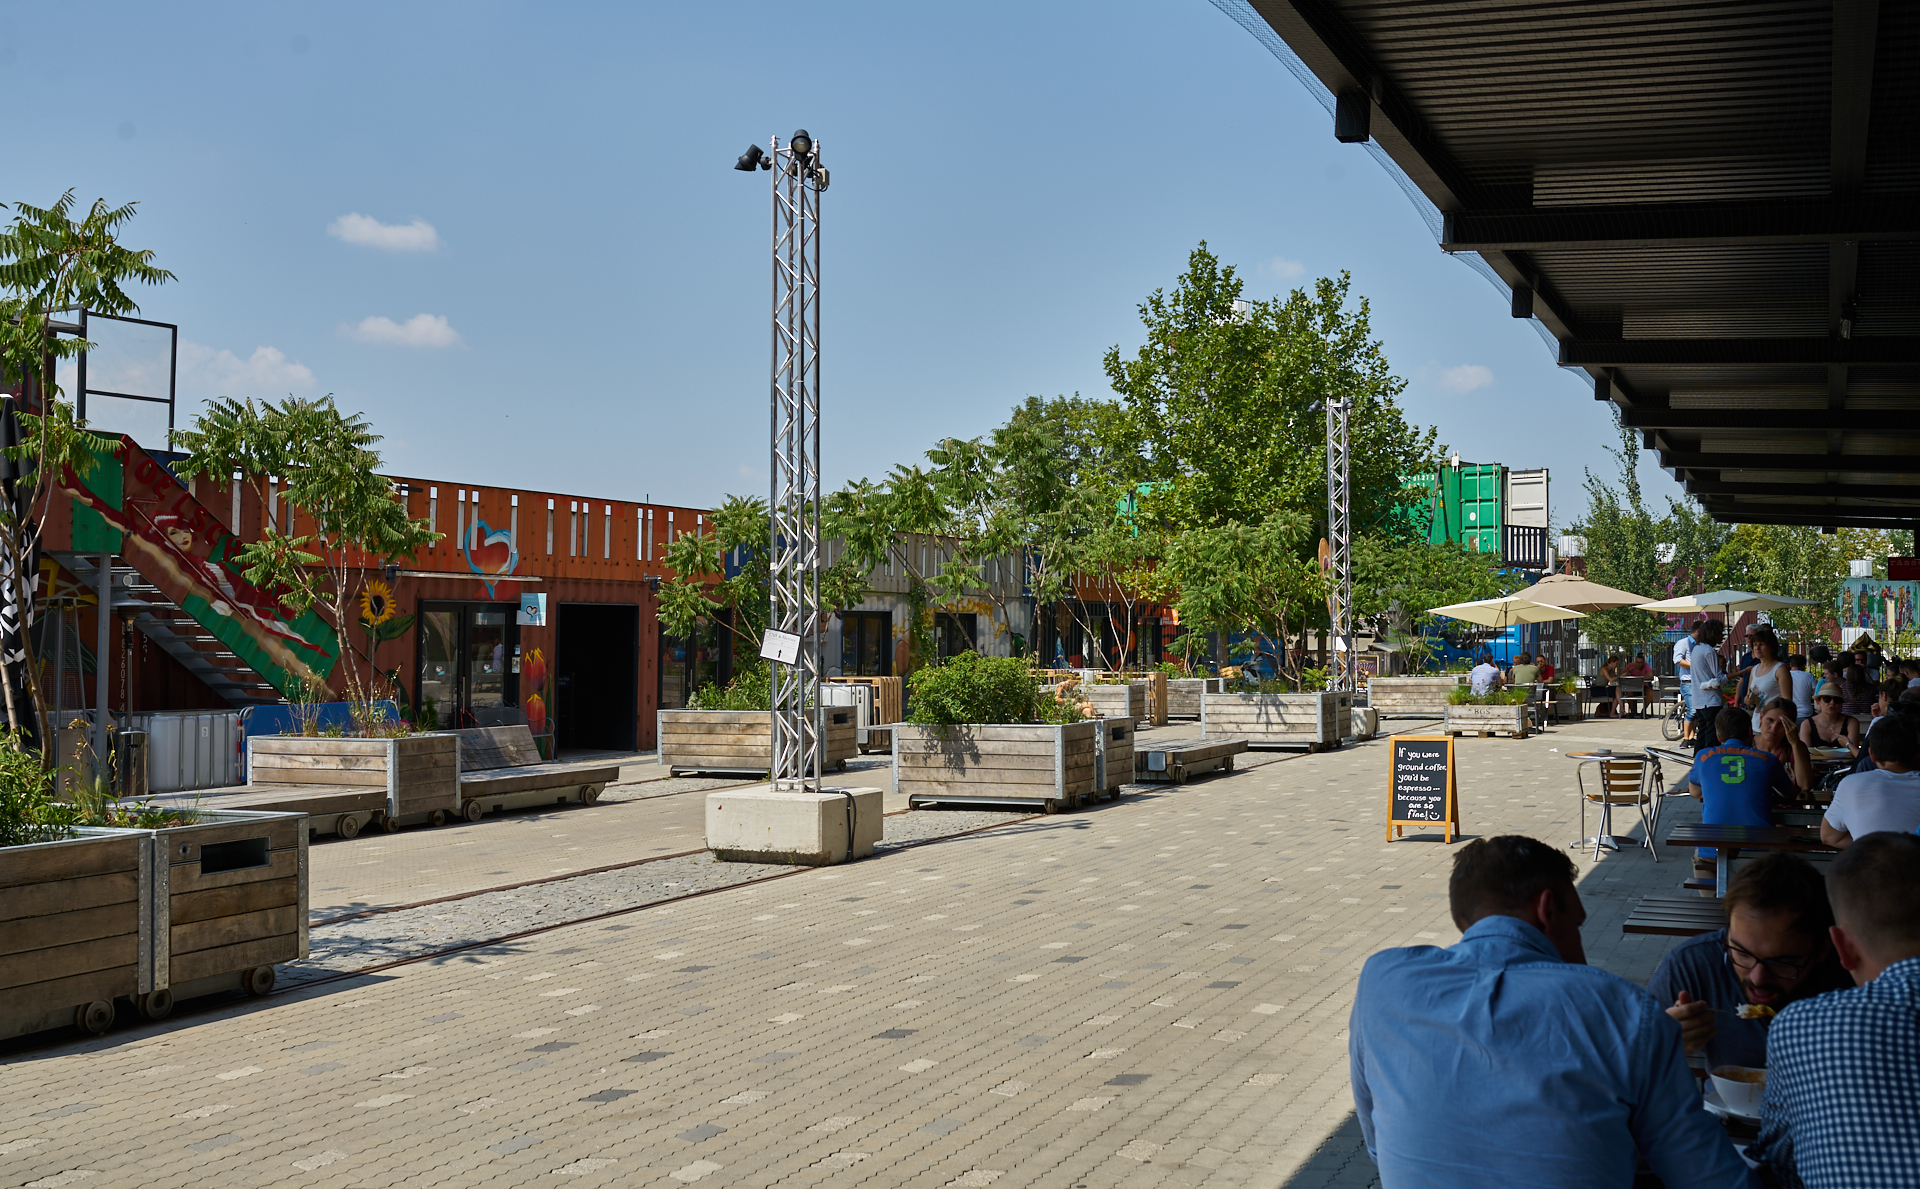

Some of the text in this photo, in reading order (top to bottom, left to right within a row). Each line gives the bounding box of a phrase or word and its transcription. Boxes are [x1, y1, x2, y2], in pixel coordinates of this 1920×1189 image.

[1398, 747, 1406, 758] If
[1407, 751, 1421, 761] you
[1700, 747, 1768, 762] SANSIBAR
[1398, 763, 1423, 771] ground
[1721, 755, 1745, 784] 3
[1397, 773, 1418, 783] you'd
[1397, 785, 1432, 793] espresso
[1397, 793, 1441, 804] because you
[1407, 809, 1428, 820] fine!
